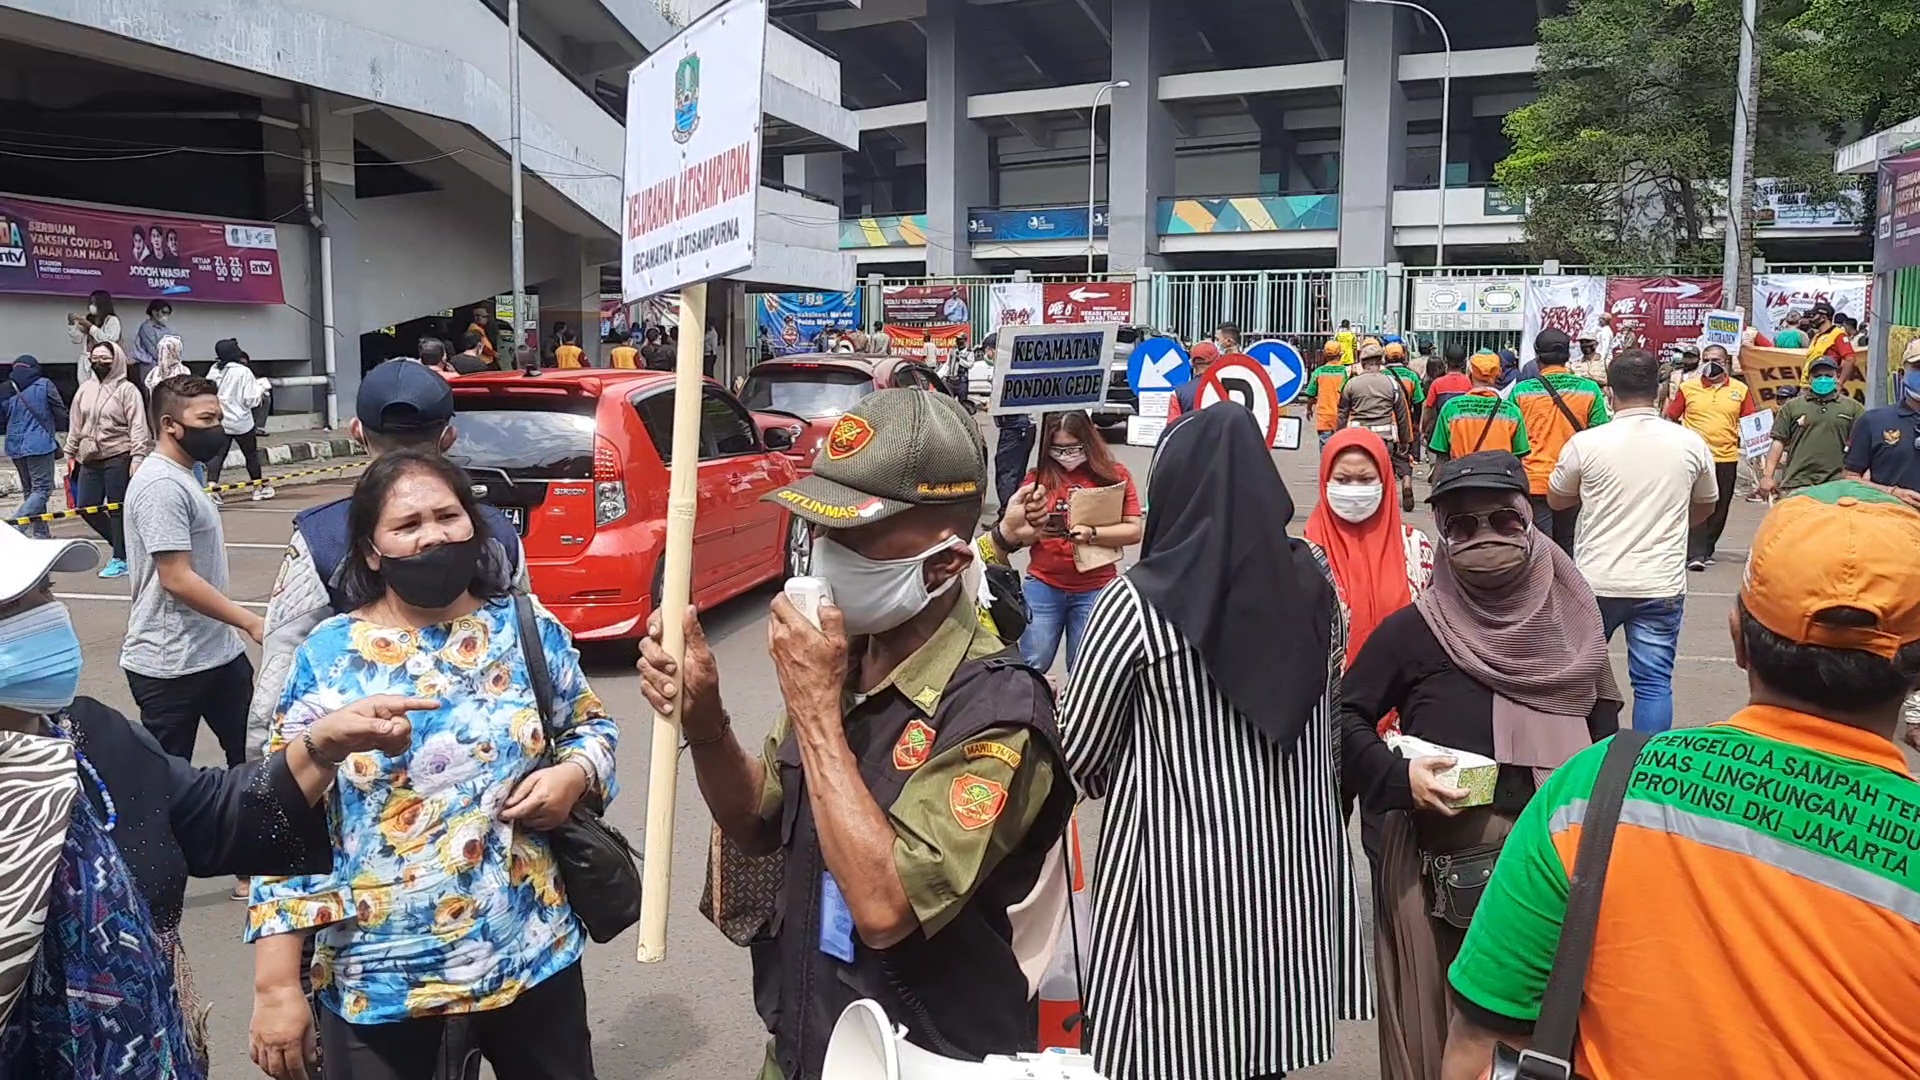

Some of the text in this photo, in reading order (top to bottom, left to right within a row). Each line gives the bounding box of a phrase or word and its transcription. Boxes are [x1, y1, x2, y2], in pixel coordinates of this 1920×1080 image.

[628, 141, 750, 241] KELURAHAN JATISAMPURNA
[28, 221, 76, 235] SERBUAN
[30, 234, 113, 250] VAKSIN COVID-19
[633, 217, 740, 275] KECAMATAN JATISAMPURNA
[32, 245, 120, 261] AMAN DAN HALAL
[129, 265, 191, 278] JODOH WASIAT
[148, 277, 175, 288] BAPAK
[1639, 299, 1649, 313] 4
[1014, 337, 1102, 362] KECAMATAN
[1004, 374, 1101, 400] PONDOK GEDE
[553, 488, 587, 496] SIRION
[777, 490, 859, 519] SATLINMAS
[966, 743, 994, 755] MAWIL
[1653, 734, 1773, 770] PENGELOLA
[1781, 756, 1880, 807] SAMPAH
[1701, 762, 1857, 827] LINGKUNGAN
[1631, 771, 1910, 877] PROVINSI DKI JAKARTA
